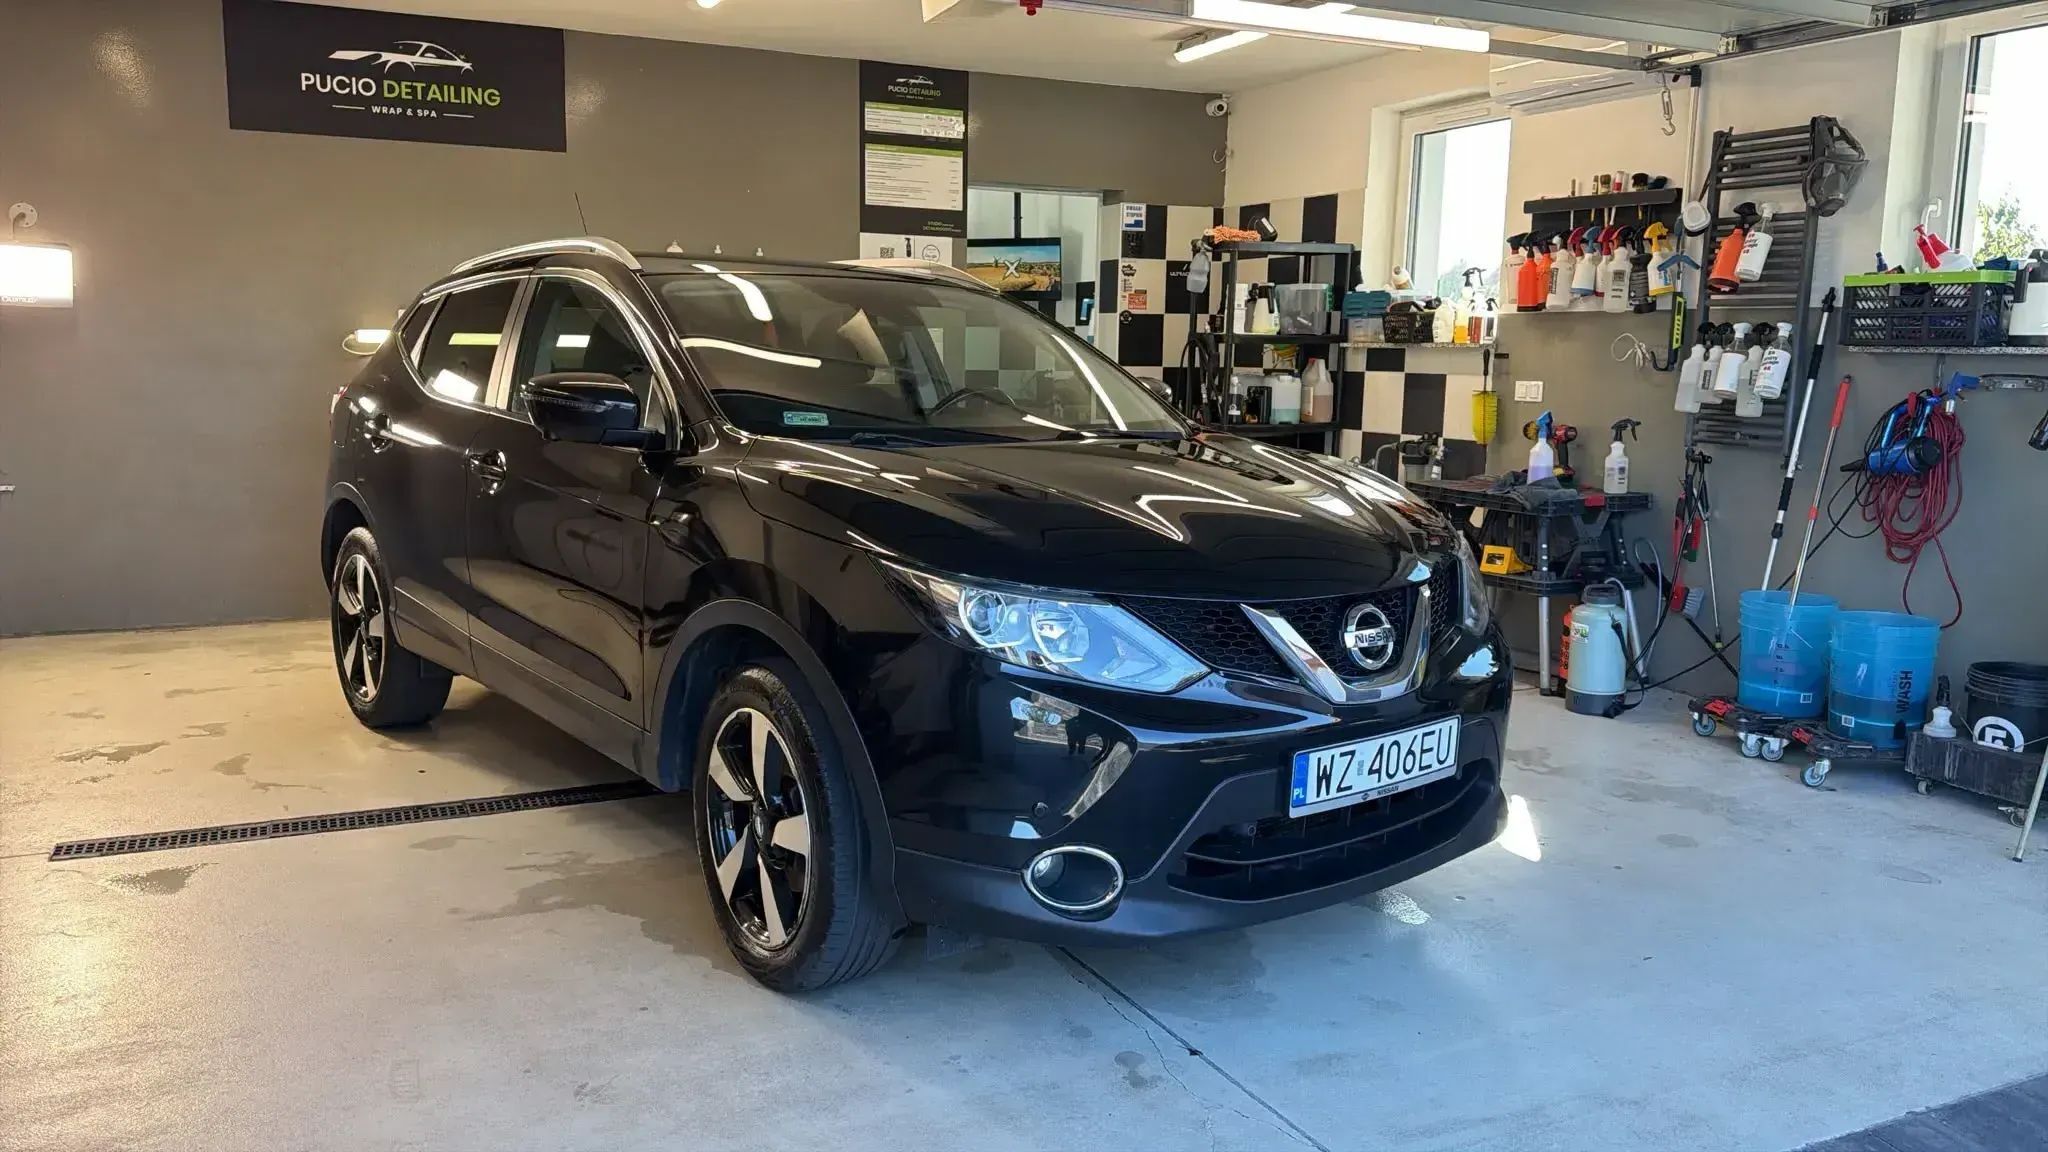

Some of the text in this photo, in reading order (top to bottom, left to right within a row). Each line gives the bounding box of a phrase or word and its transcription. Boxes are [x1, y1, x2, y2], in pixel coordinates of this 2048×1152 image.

[300, 72, 501, 106] PUCIO DETAILING
[371, 105, 438, 119] WRAP & SPA
[1355, 629, 1393, 644] NISSAN
[1896, 670, 1913, 714] WASH
[1316, 725, 1453, 799] WZ 406EU
[1293, 788, 1305, 799] PL
[1376, 785, 1400, 797] NISSAN
